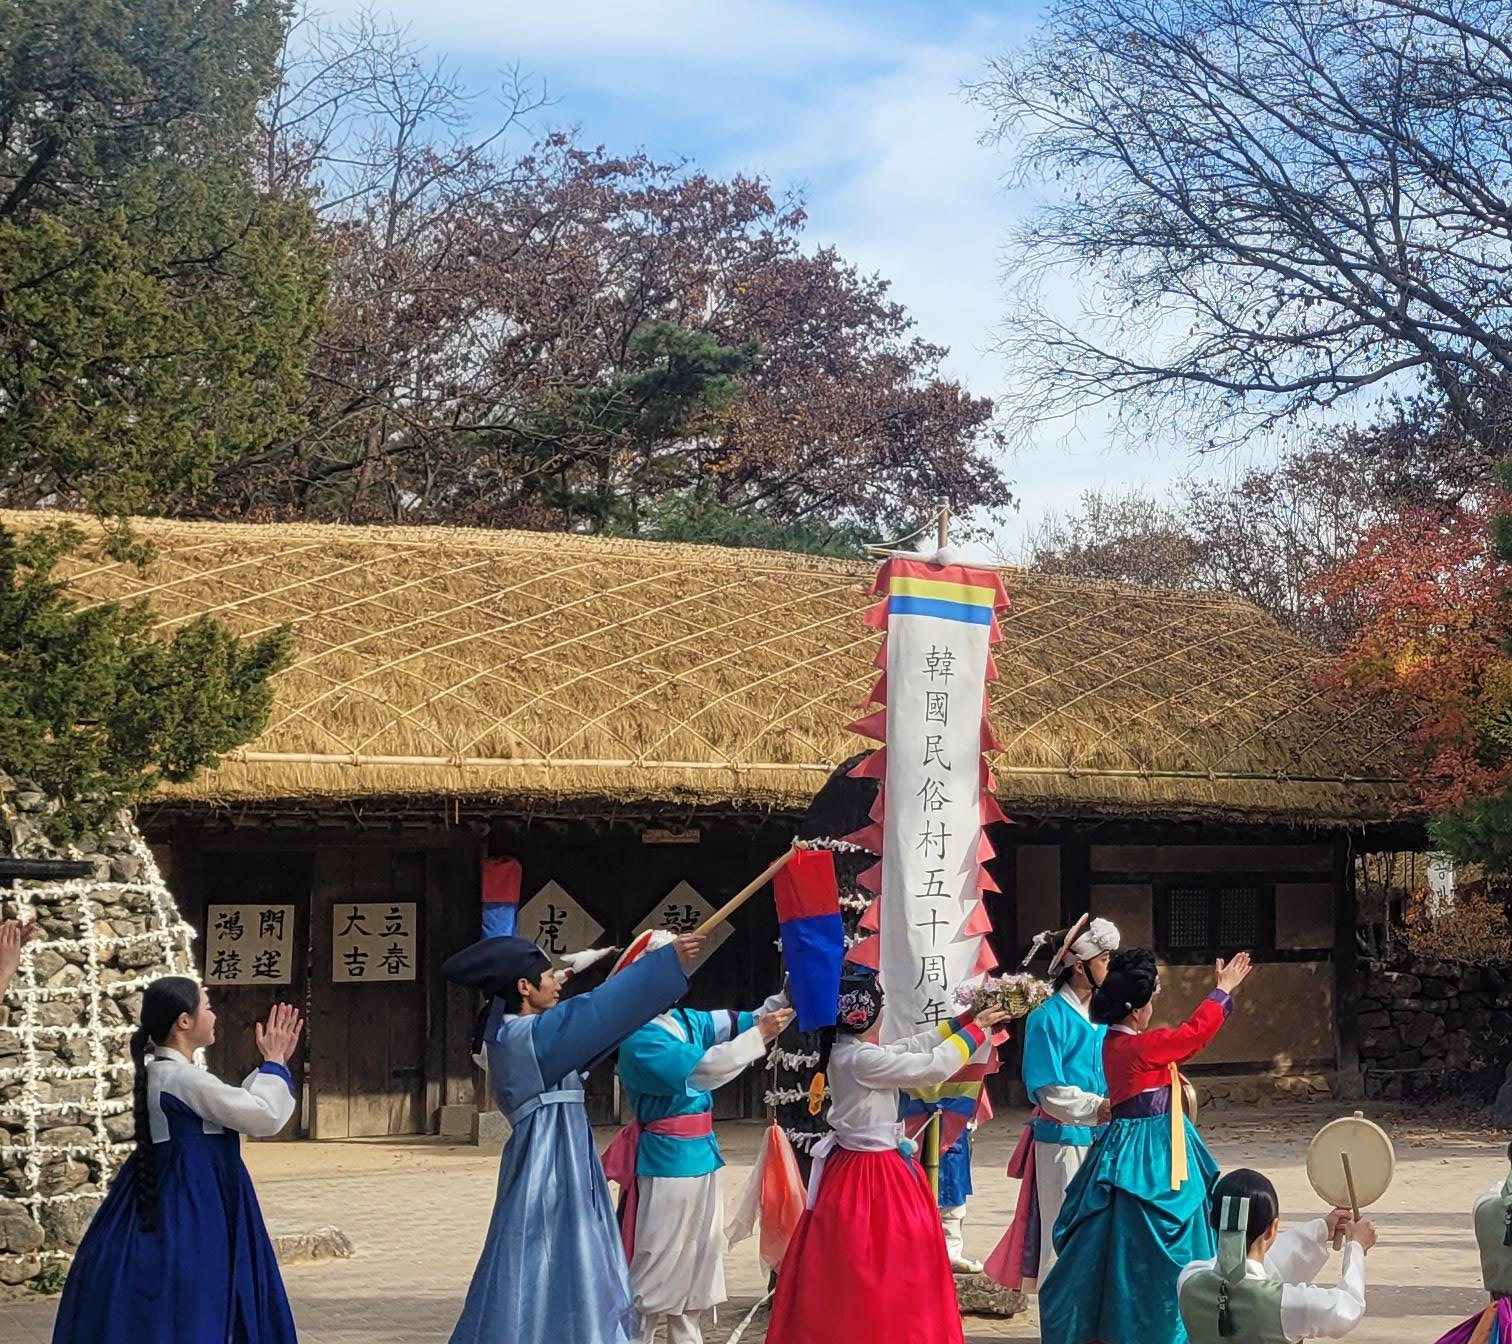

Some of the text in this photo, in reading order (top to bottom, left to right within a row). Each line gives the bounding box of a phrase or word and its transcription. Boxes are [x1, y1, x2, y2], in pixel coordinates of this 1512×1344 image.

[915, 645, 956, 1027] 韓國民俗村五十周年
[252, 909, 285, 978] 開運
[337, 906, 372, 977] 大吉
[376, 907, 411, 976] 立春
[535, 904, 568, 954] 虎
